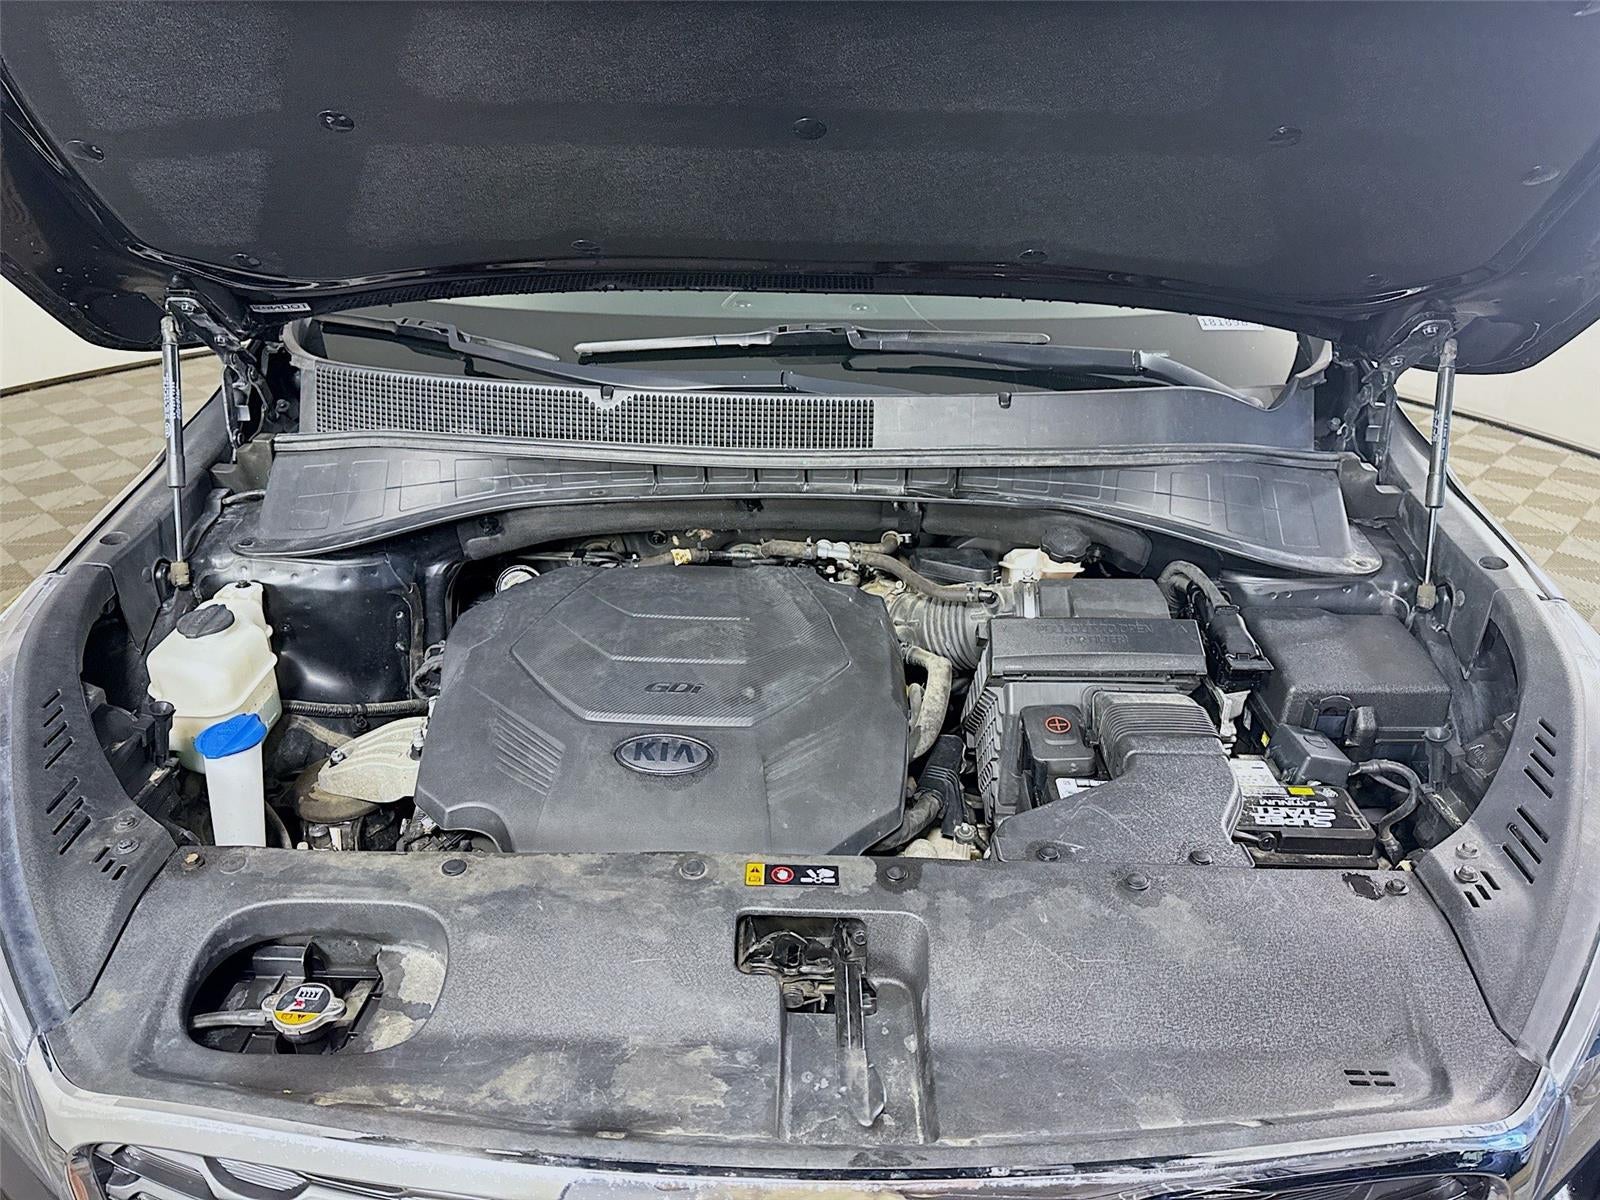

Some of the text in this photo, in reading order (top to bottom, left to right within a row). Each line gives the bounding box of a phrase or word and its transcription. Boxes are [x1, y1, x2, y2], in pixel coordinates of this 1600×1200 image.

[1119, 623, 1153, 634] OPEN
[633, 742, 695, 764] KIA
[1259, 799, 1328, 808] PLATINUM
[1249, 806, 1337, 821] START
[1254, 815, 1333, 828] SUPER
